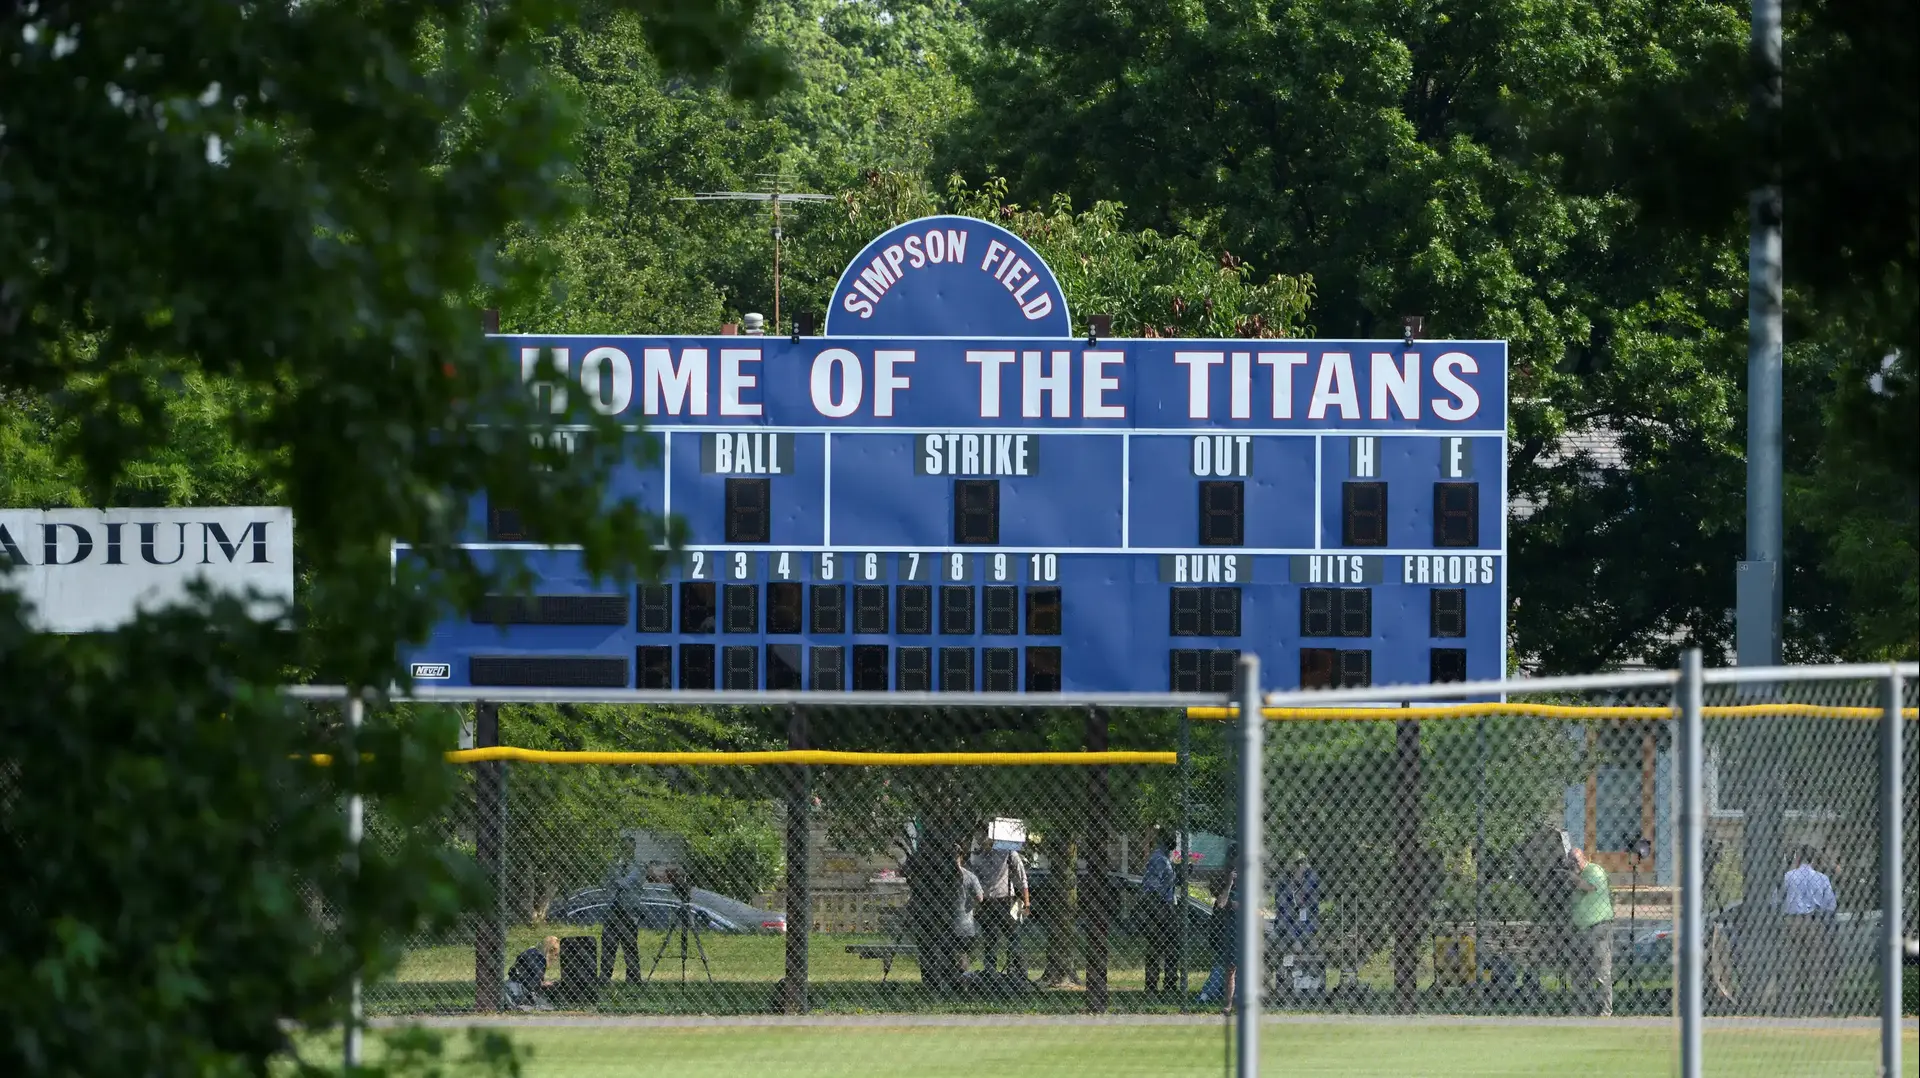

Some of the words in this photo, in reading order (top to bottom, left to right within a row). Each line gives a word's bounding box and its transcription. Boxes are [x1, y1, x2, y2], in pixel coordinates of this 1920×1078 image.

[843, 229, 968, 319] SIMPSON
[981, 239, 1053, 321] FIELD
[809, 348, 917, 419] OF
[965, 350, 1126, 419] THE
[1174, 351, 1481, 421] TITANS
[714, 433, 781, 474] BALL
[925, 434, 1029, 476] STRIKE
[1193, 436, 1251, 477] OUT
[1356, 437, 1374, 477] H
[1450, 438, 1463, 477] E
[692, 551, 704, 579] 2
[735, 552, 747, 579] 3
[778, 552, 790, 580] 4
[822, 552, 834, 580] 5
[865, 553, 877, 580] 6
[908, 553, 920, 580] 7
[951, 553, 963, 581] 8
[994, 553, 1006, 581] 9
[1031, 553, 1057, 581] 10
[1175, 555, 1237, 583] RUNS
[1309, 555, 1363, 583] HITS
[1404, 556, 1493, 584] ERRORS
